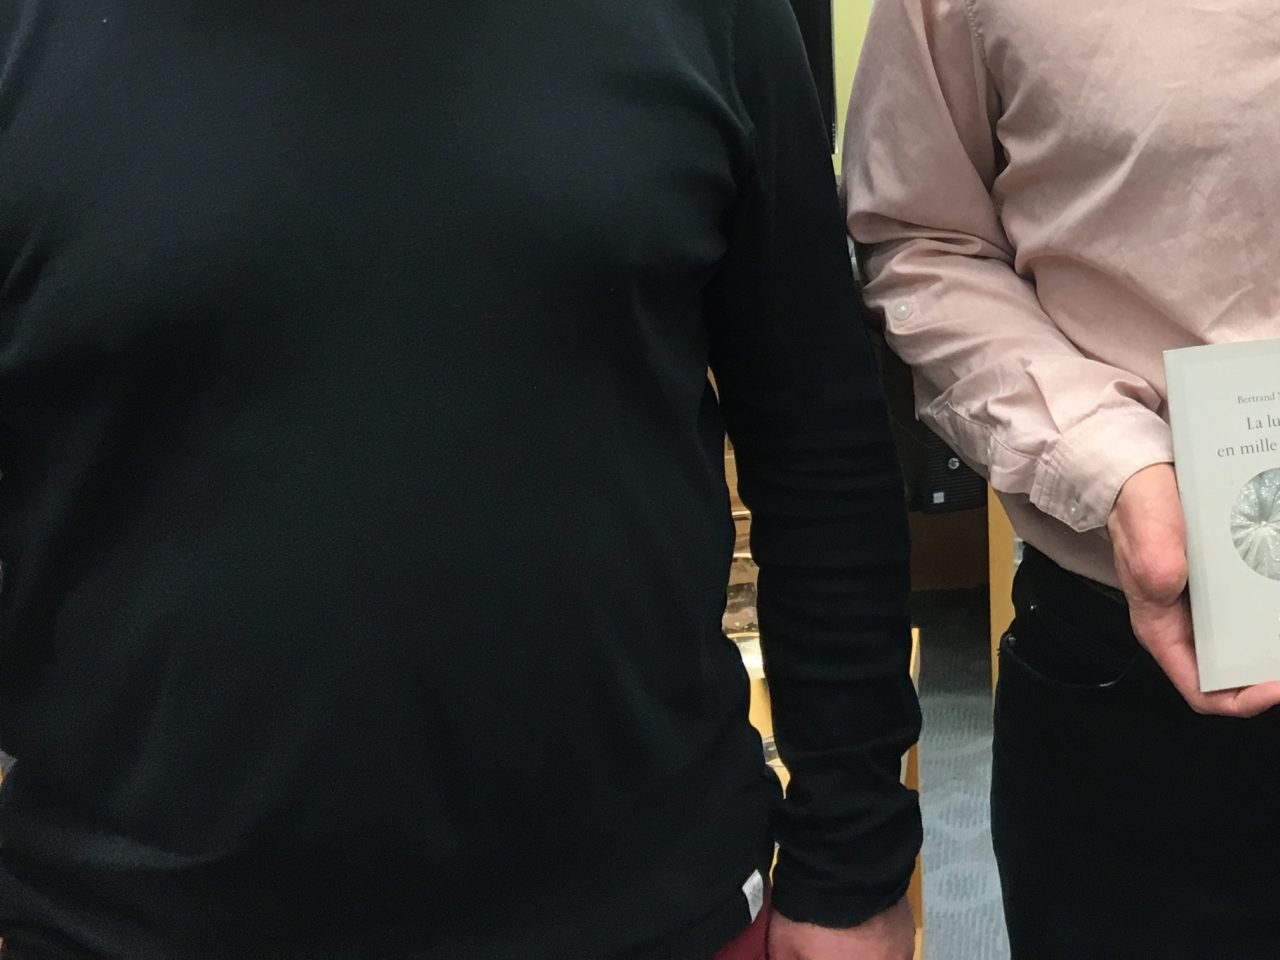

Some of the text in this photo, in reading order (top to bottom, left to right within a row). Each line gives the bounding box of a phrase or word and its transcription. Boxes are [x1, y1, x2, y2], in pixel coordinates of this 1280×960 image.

[1237, 392, 1275, 405] Bertrand
[1246, 416, 1263, 431] La
[1217, 445, 1235, 458] en
[1239, 437, 1278, 455] mille
